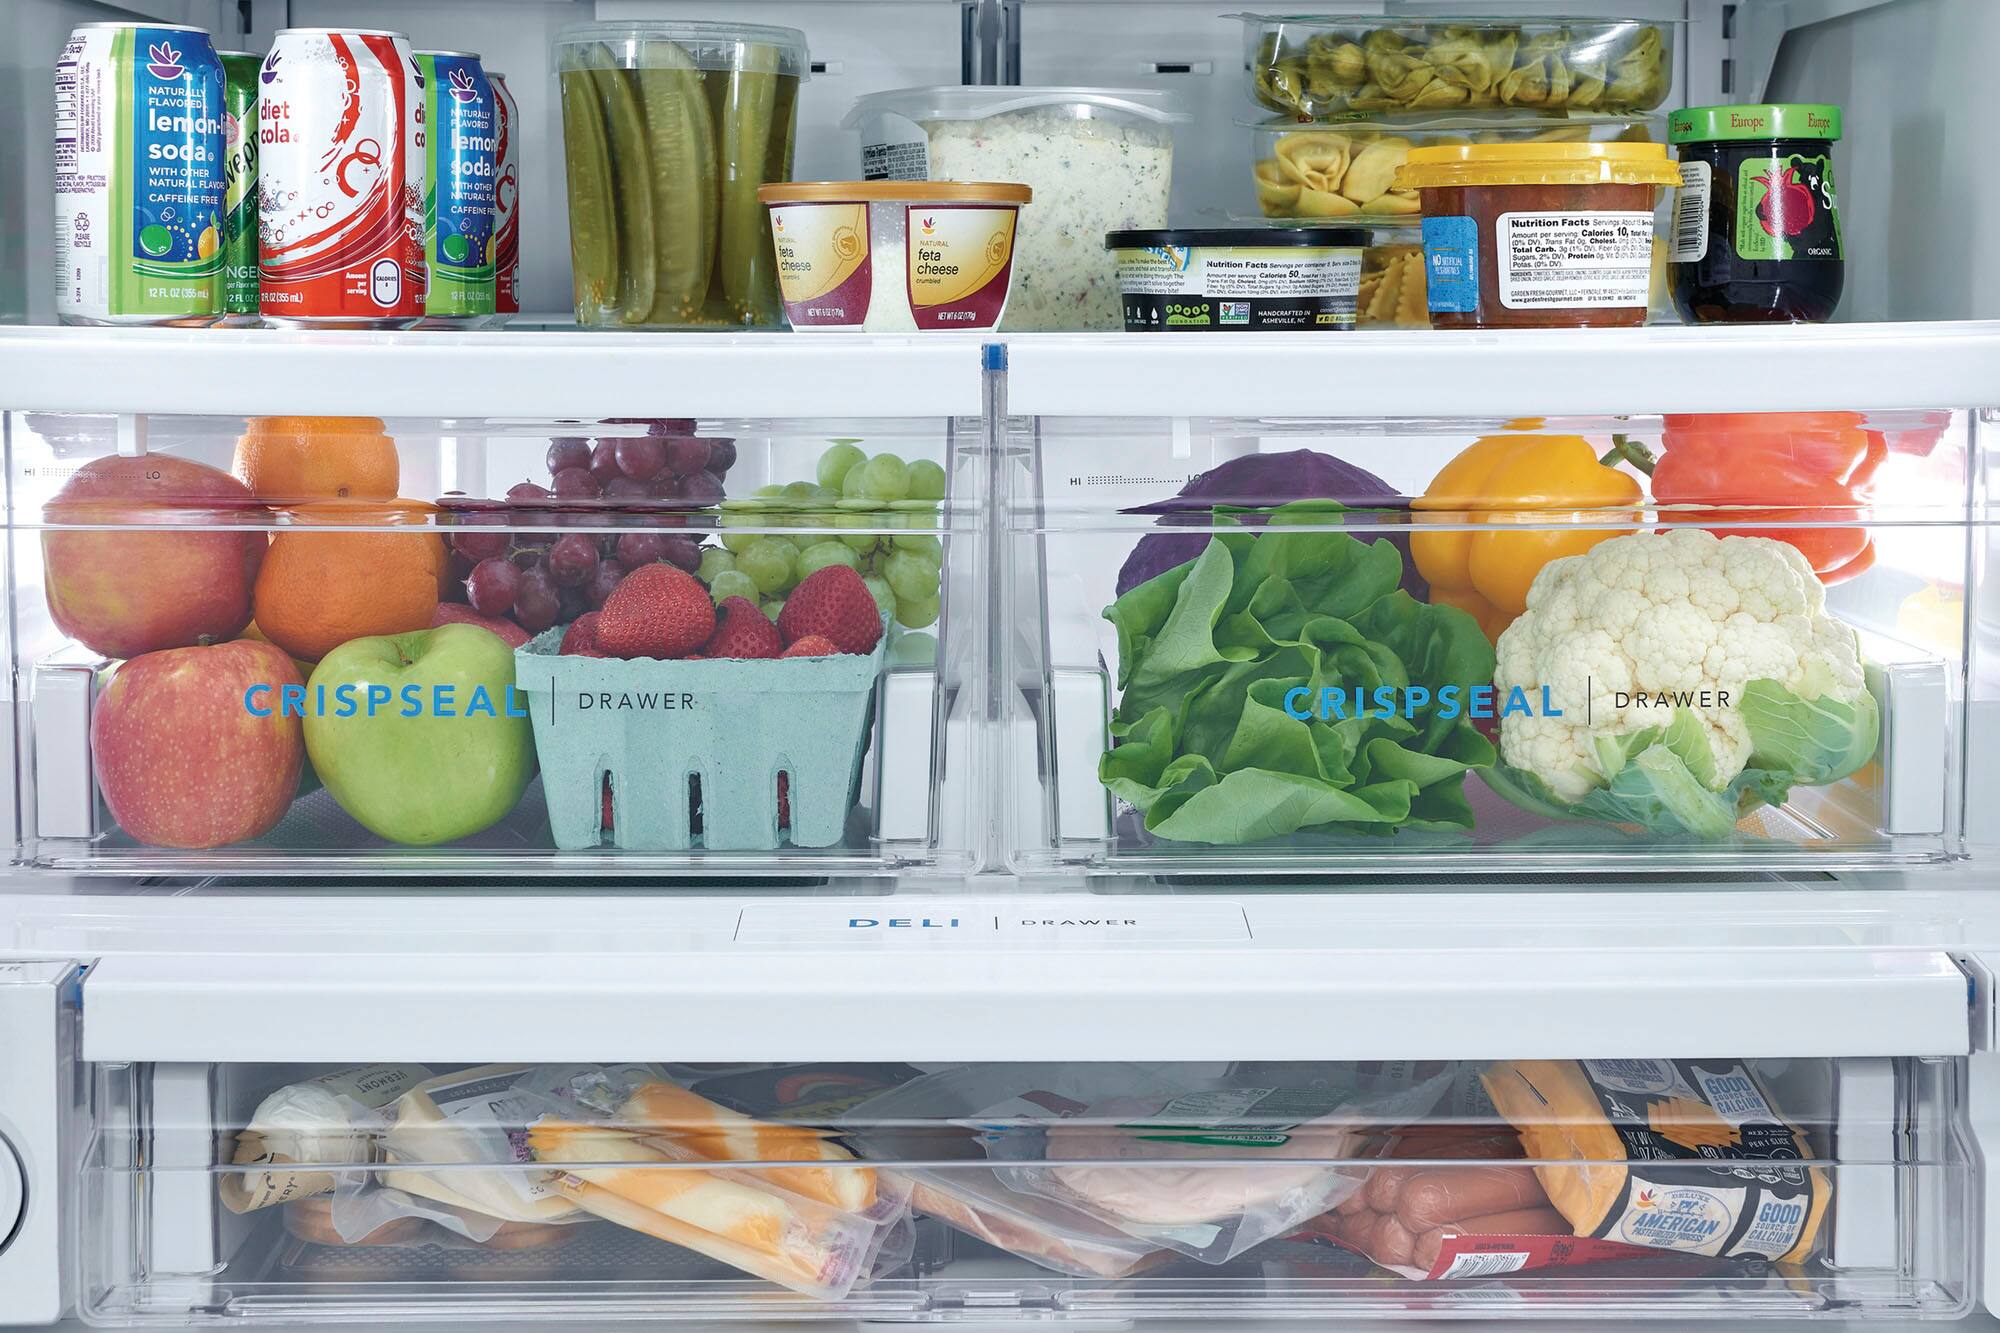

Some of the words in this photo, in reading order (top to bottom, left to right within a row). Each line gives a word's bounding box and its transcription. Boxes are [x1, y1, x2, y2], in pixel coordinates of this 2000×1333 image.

[148, 87, 206, 98] NATURALLY
[148, 98, 202, 108] FLAVORED
[260, 98, 290, 120] diet
[450, 109, 490, 120] NATURALLY
[450, 120, 489, 129] FLAVORED
[1674, 119, 1692, 135] Europe
[1731, 113, 1764, 132] Europe
[1808, 112, 1830, 133] Europe
[260, 121, 290, 144] cola
[149, 167, 178, 176] WITH
[180, 168, 209, 178] OTHER
[149, 179, 198, 188] NATURAL
[451, 182, 472, 190] WITH
[474, 182, 492, 192] OTHER
[149, 194, 198, 204] CAFFEINE
[200, 196, 218, 205] FREE
[451, 192, 485, 202] NATURAL
[450, 206, 486, 214] CAFFEINE
[1512, 219, 1558, 228] Nutrition
[1562, 218, 1590, 226] Facts
[778, 246, 794, 258] feta
[918, 248, 942, 262] feta
[780, 260, 812, 272] cheese
[916, 262, 959, 275] cheese
[149, 288, 157, 297] 12
[160, 288, 168, 298] FL
[170, 289, 180, 298] OZ
[938, 312, 946, 320] NET
[146, 471, 161, 480] LO
[1070, 478, 1081, 486] HI
[244, 684, 528, 718] CRISPSEAL
[579, 692, 695, 710] DRAWER
[1284, 684, 1564, 720] CRISPSEAL
[1614, 691, 1730, 709] DRAWER
[848, 918, 960, 928] DELI
[1704, 1077, 1752, 1094] GOOD
[1713, 1092, 1744, 1102] SOURCE
[1716, 1097, 1764, 1114] CALCIUM
[1701, 1147, 1718, 1158] 80
[1671, 1192, 1711, 1203] DELUXE
[1758, 1202, 1802, 1224] GOOD
[1632, 1212, 1720, 1235] AMERICAN
[1754, 1222, 1784, 1230] SOURCE
[1748, 1230, 1794, 1244] CALCIUM
